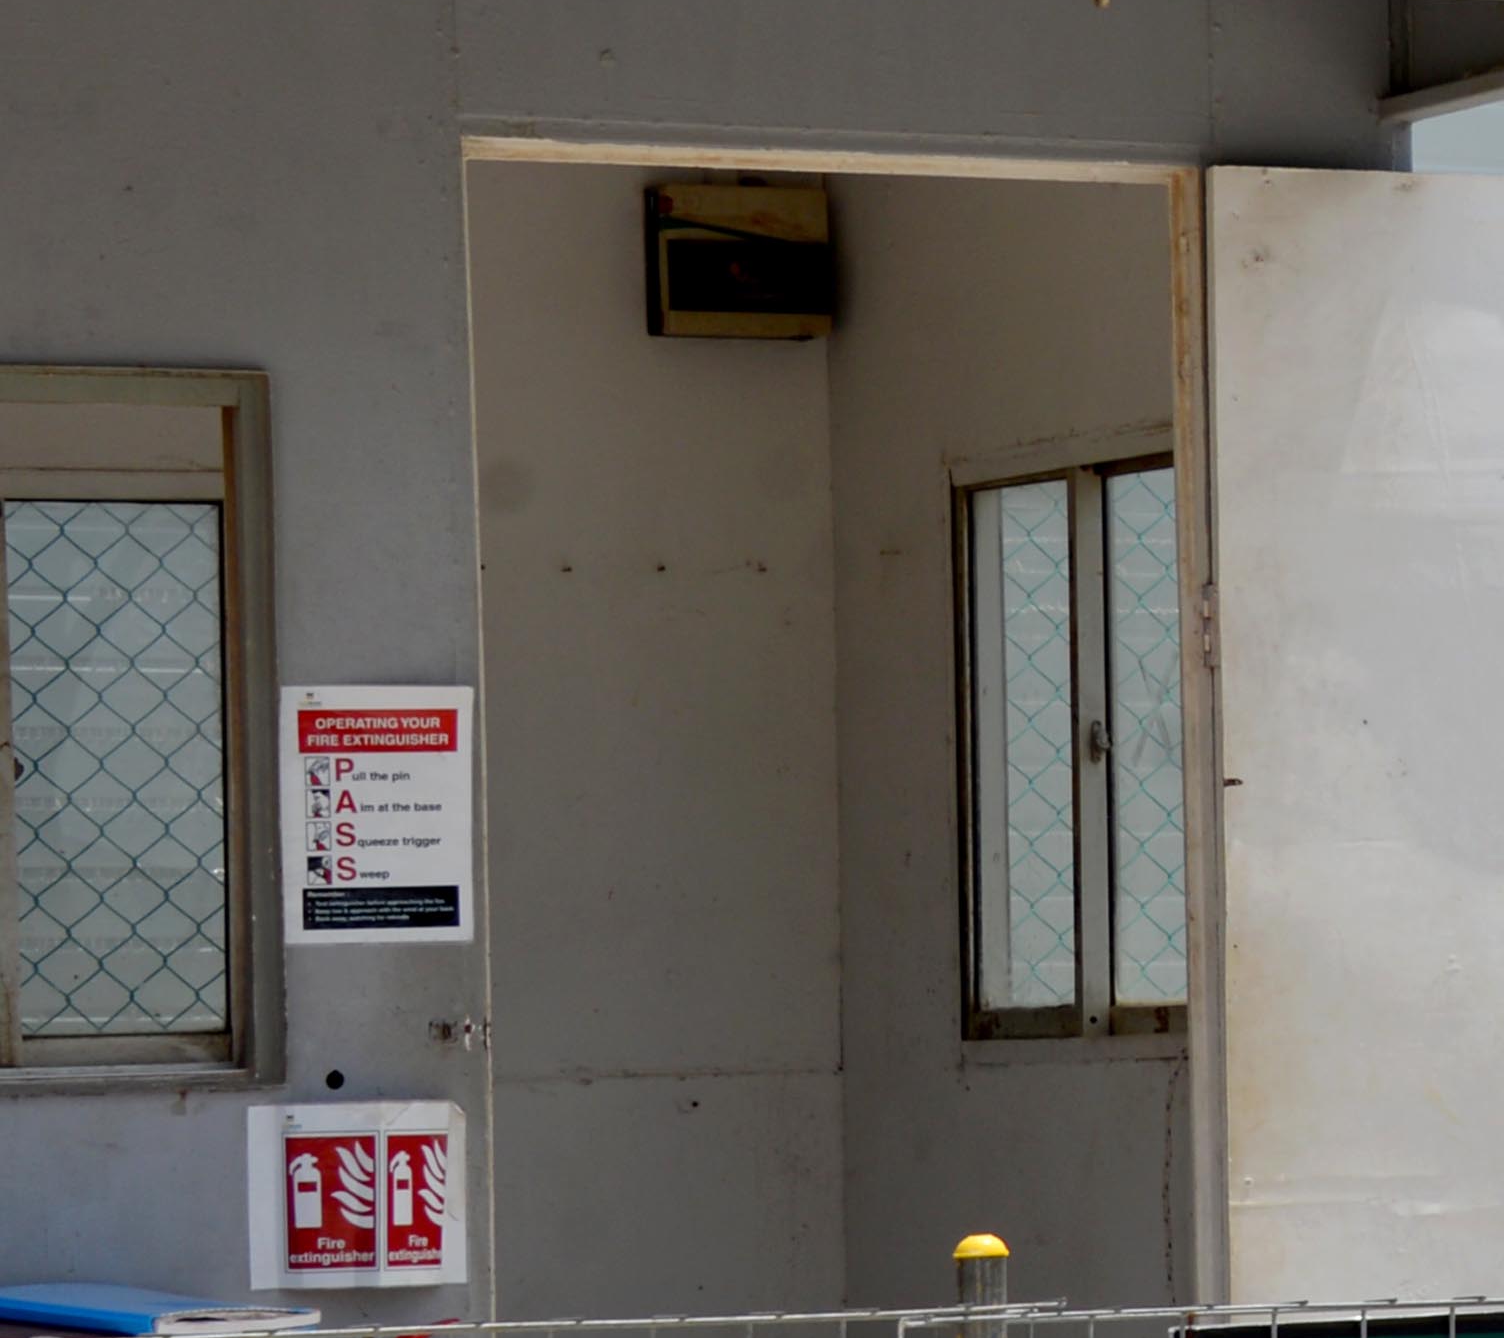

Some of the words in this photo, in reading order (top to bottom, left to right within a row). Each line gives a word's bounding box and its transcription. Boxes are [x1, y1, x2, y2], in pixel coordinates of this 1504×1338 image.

[314, 717, 398, 730] OPERATING
[400, 716, 440, 729] YOUR
[307, 734, 339, 747] FIRE
[343, 733, 449, 746] EXTINGUISHER
[369, 771, 389, 782] the
[391, 771, 411, 783] pin
[378, 803, 389, 812] at
[392, 802, 411, 812] the
[413, 802, 442, 812] base
[402, 836, 441, 848] trigger
[316, 1236, 346, 1251] Fire
[407, 1234, 429, 1247] Fire
[290, 1250, 375, 1265] extinguisher
